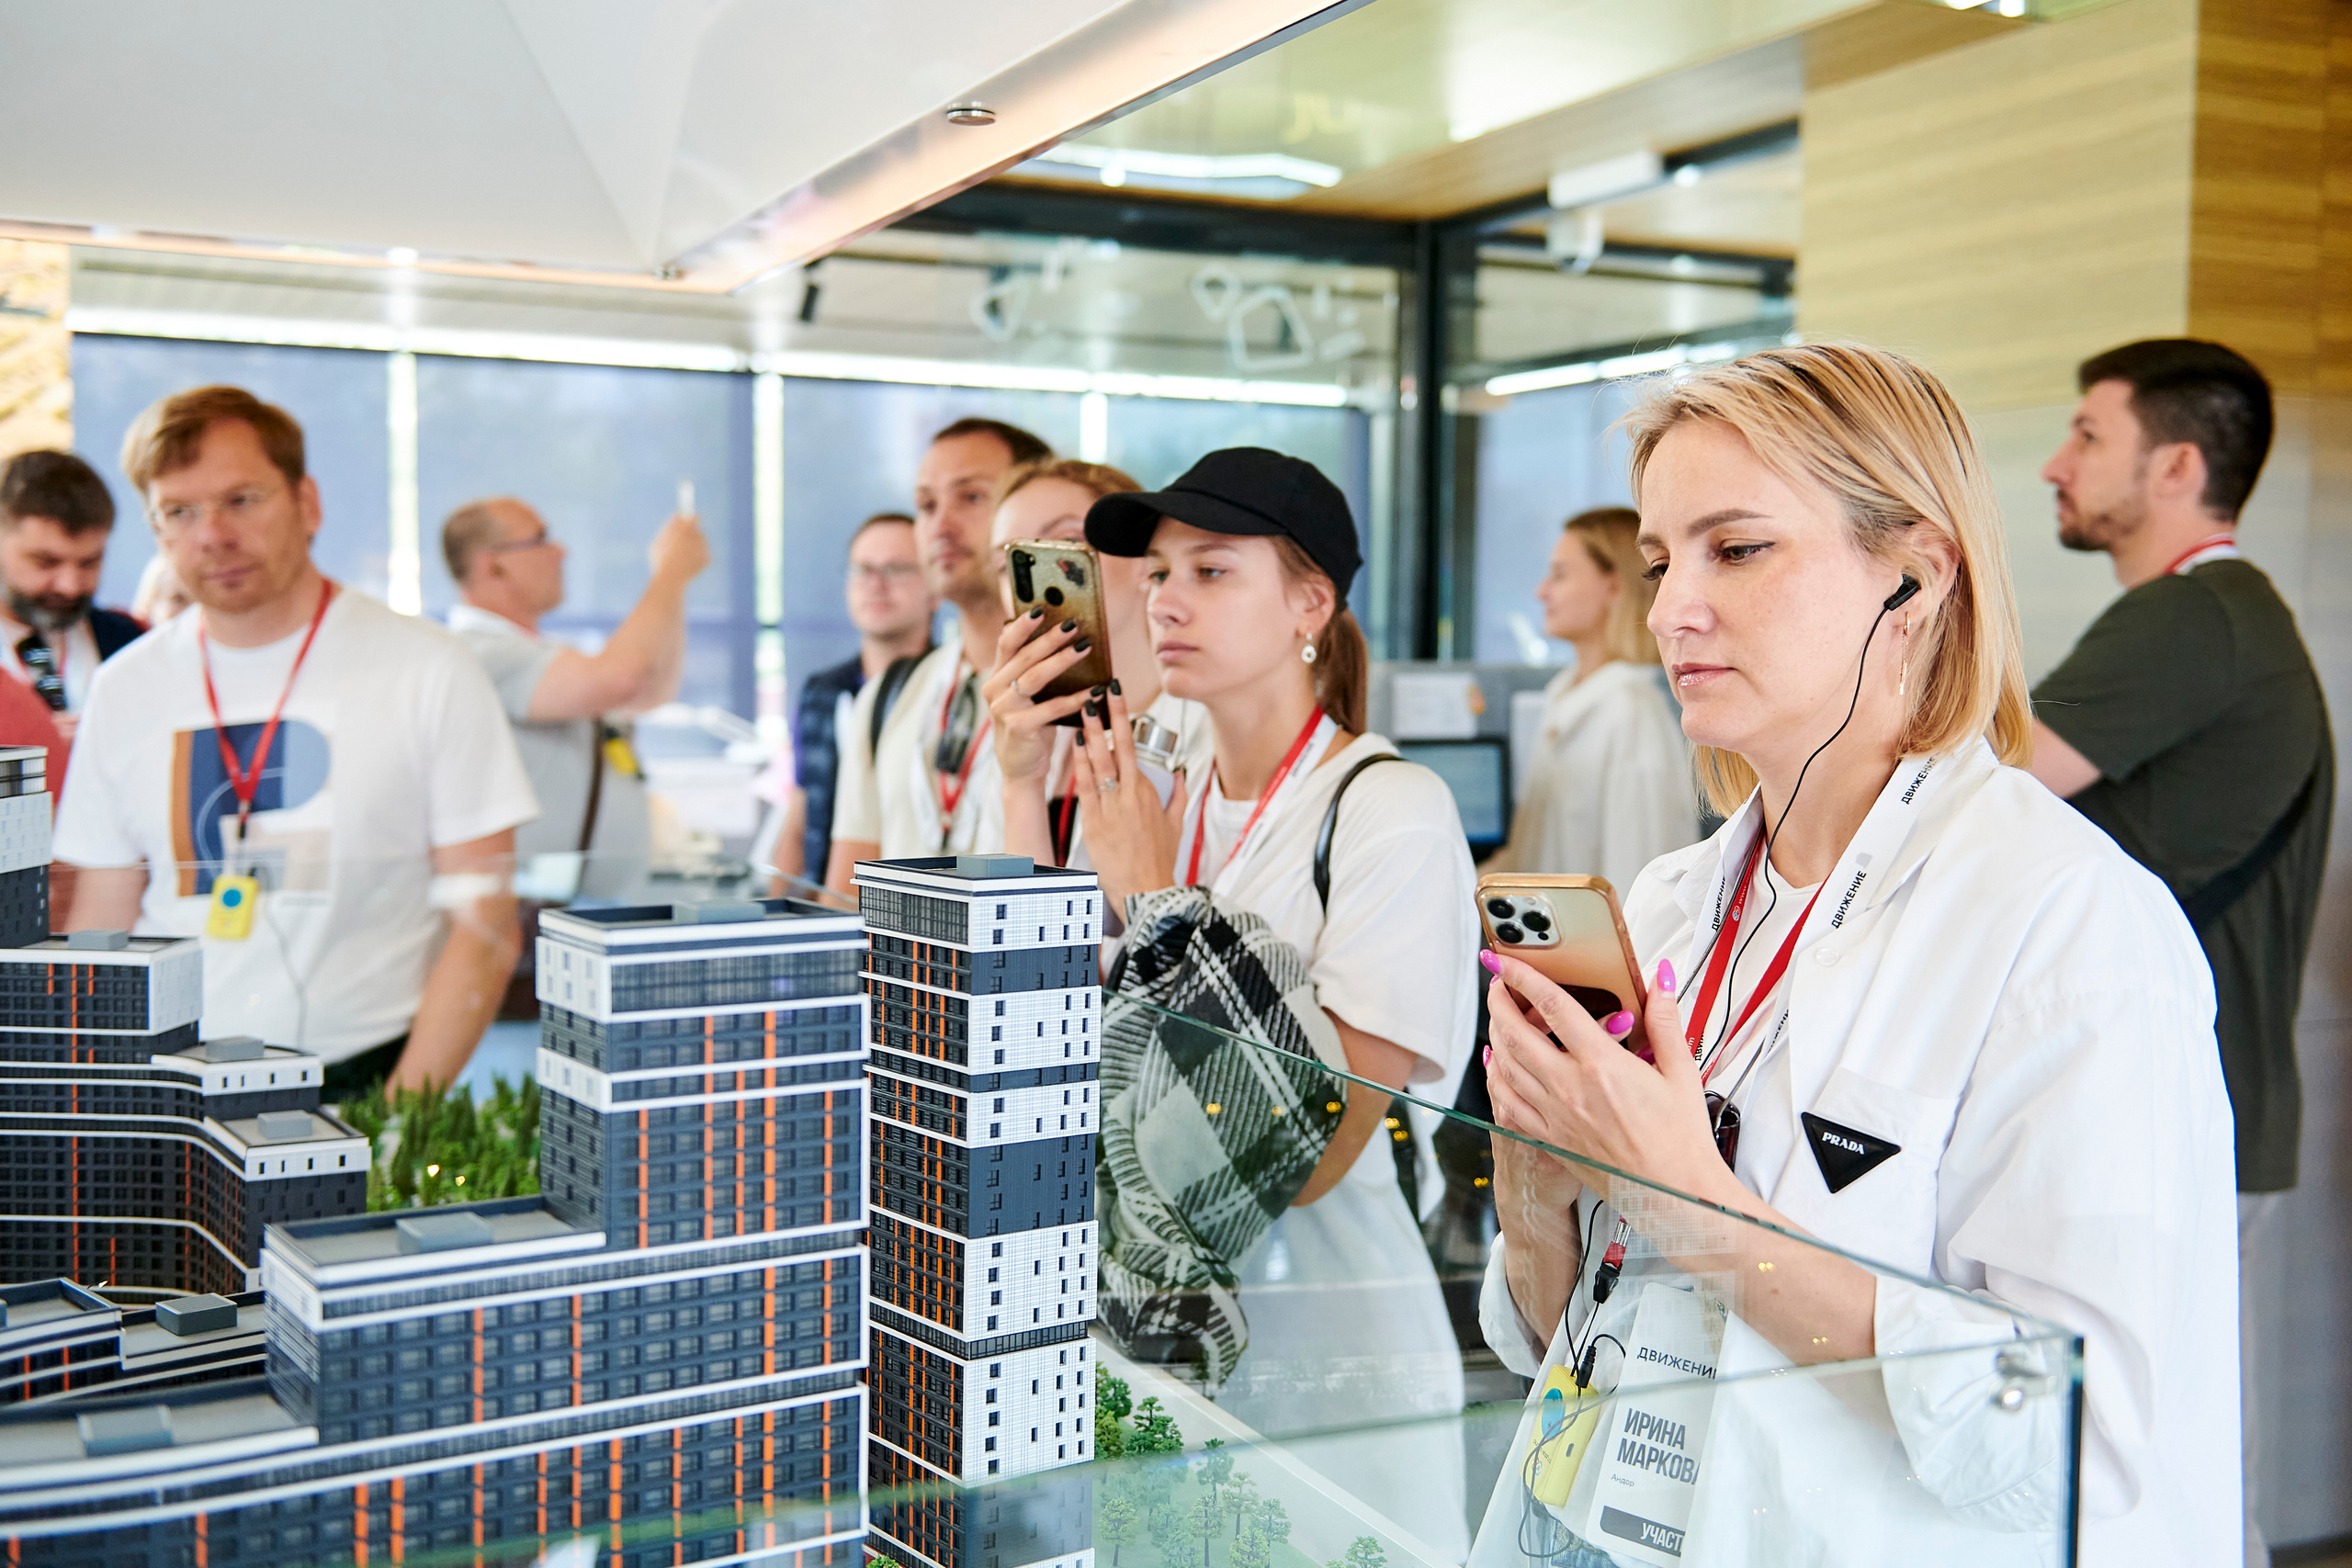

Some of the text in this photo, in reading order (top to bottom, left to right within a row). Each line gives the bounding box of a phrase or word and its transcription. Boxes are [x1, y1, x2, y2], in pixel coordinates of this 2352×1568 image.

[1831, 870, 1867, 930] ДВИЖЕНИЕ
[1822, 1131, 1865, 1156] PRADA
[1636, 1347, 1717, 1380] ДВИЖЕНИ
[1623, 1407, 1686, 1450] ИРИНА
[1611, 1473, 1634, 1487] Андор
[1641, 1522, 1685, 1553] УЧАСТ
